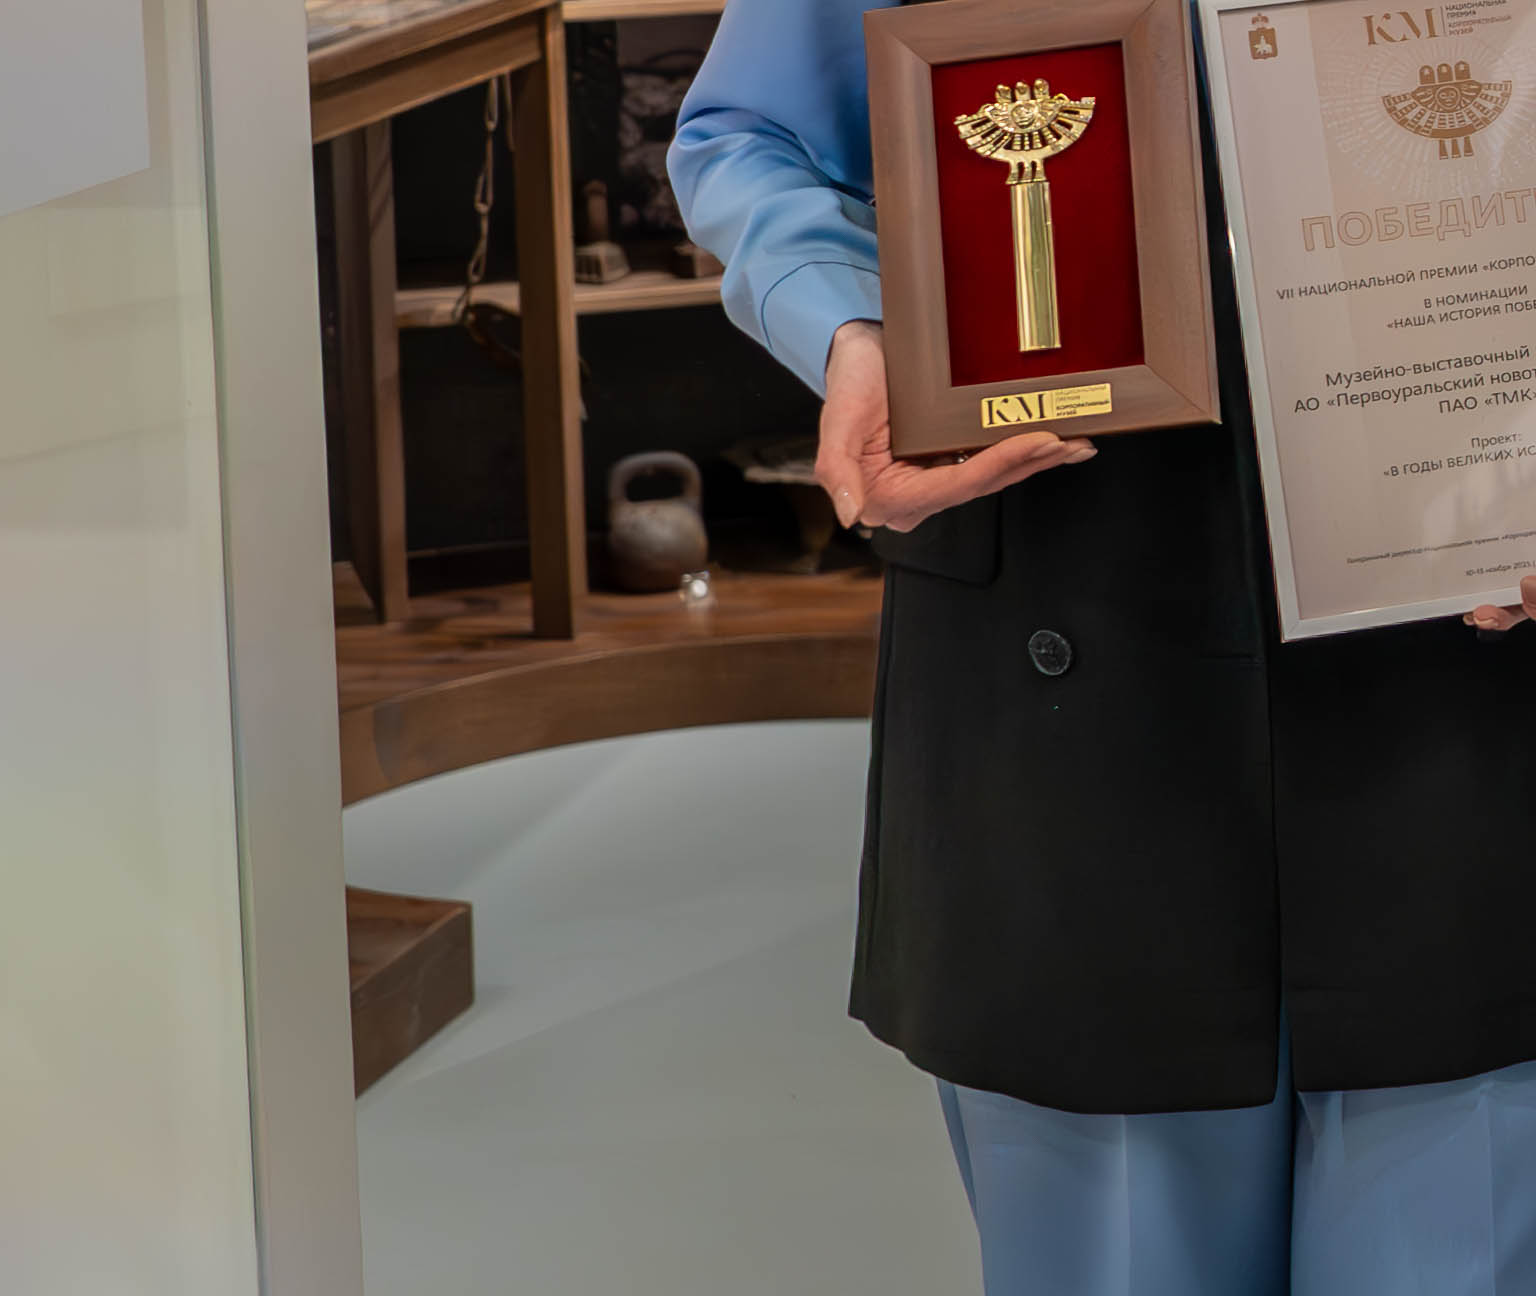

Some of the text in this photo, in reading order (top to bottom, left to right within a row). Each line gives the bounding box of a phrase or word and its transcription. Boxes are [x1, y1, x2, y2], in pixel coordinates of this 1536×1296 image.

[1276, 288, 1294, 299] VII
[1299, 270, 1415, 297] НАЦИОНАЛЬНОЙ
[1420, 264, 1477, 280] ПРЕМИИ
[1424, 285, 1527, 308] В НОМИНАЦИИ
[1439, 302, 1501, 322] ИСТОРИЯ
[1326, 345, 1529, 389] Музейно-выставочный
[1295, 397, 1319, 413] АО
[1439, 396, 1477, 413] ПАО
[1471, 434, 1521, 450] Проект:
[1403, 460, 1442, 474] ГОДЫ
[1447, 450, 1513, 468] ВЕЛИКИХ
